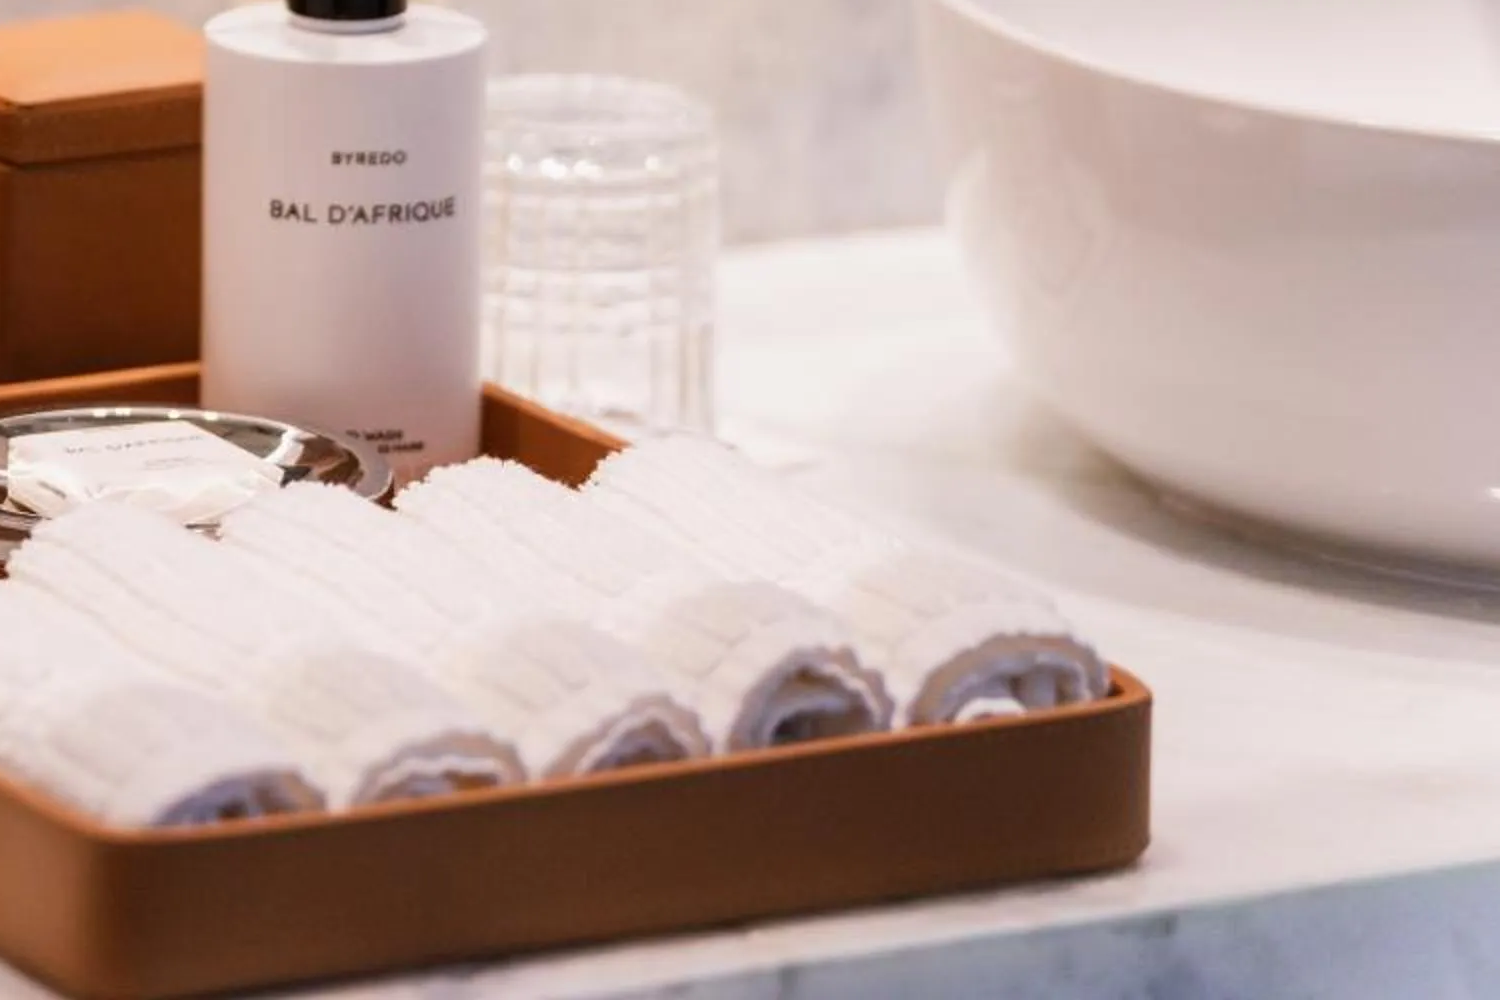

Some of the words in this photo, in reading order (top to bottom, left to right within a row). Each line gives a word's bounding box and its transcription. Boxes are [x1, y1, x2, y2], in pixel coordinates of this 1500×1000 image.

[330, 149, 408, 166] BYREDO
[269, 198, 318, 224] BAL
[327, 196, 456, 225] D'AFRIQUE
